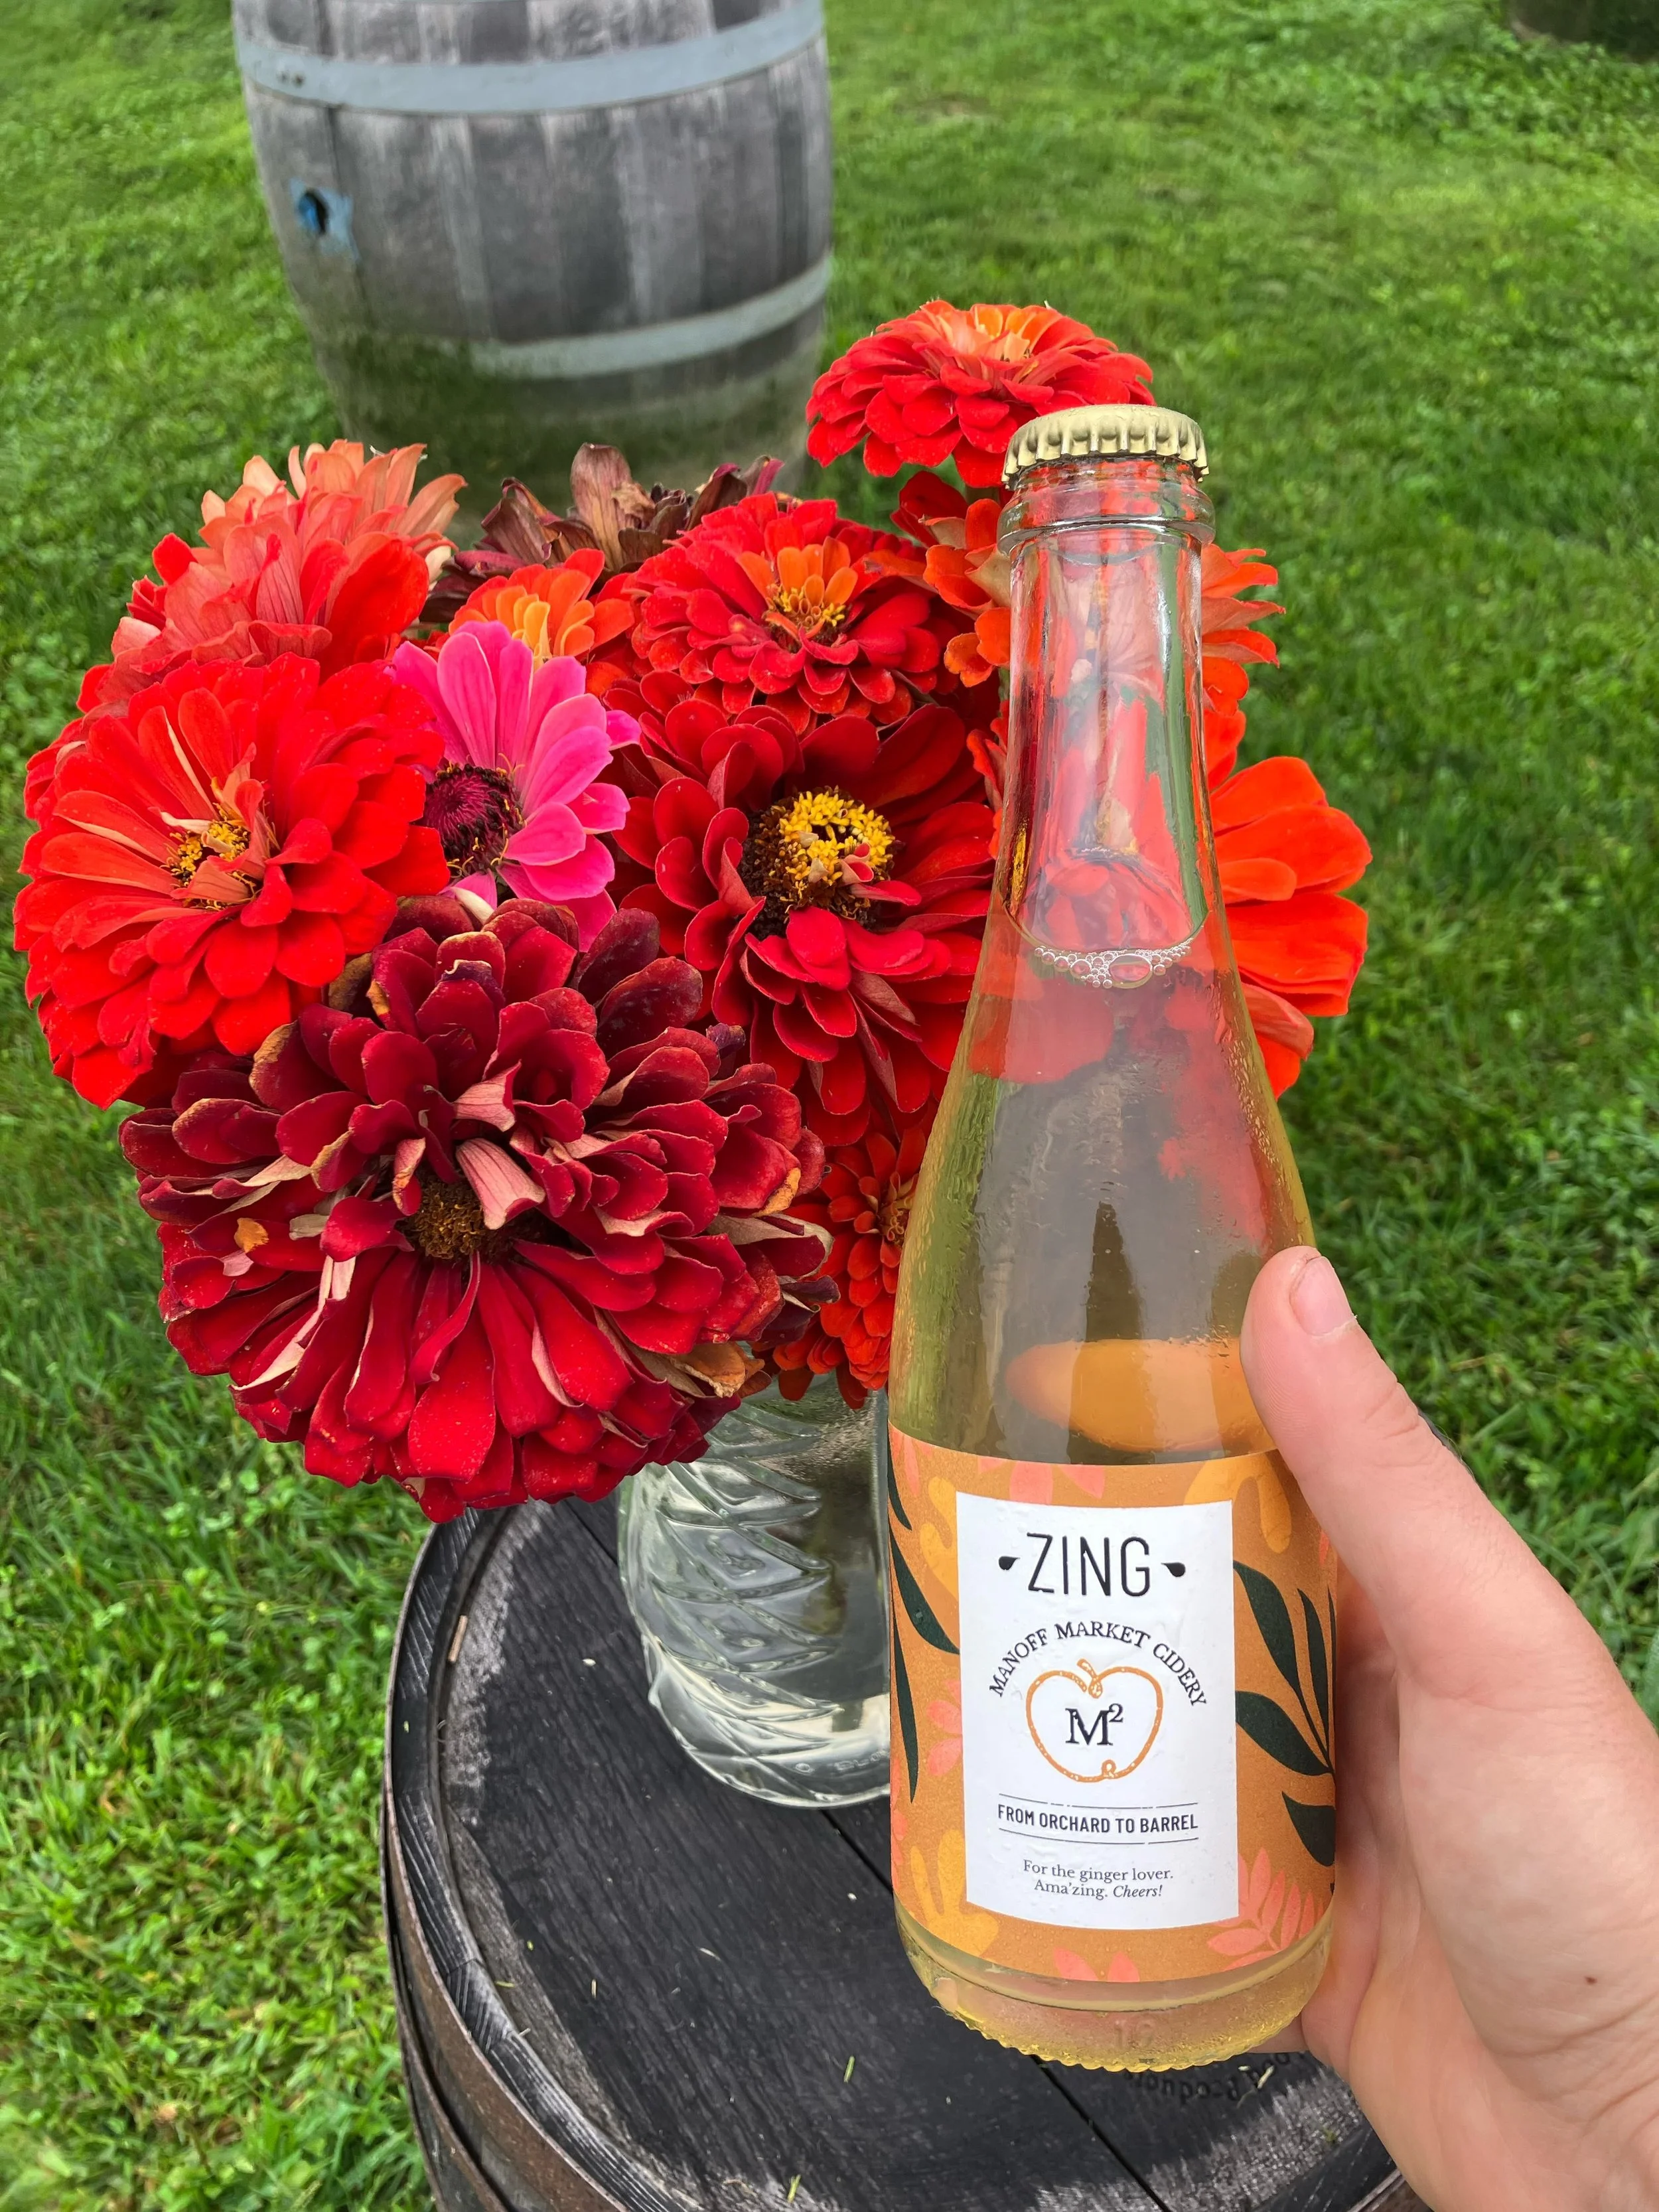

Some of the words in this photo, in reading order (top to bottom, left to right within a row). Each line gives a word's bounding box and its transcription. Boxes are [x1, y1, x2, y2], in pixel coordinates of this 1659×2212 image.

[1027, 1532, 1151, 1597] ZING
[989, 1628, 1047, 1697] MANOFF
[1054, 1621, 1151, 1648] MARKET
[1153, 1643, 1207, 1706] CIDERY
[998, 1804, 1035, 1826] FROM
[1039, 1812, 1110, 1833] ORCHARD
[1115, 1818, 1135, 1834] TO
[1140, 1814, 1198, 1833] BARREL
[1023, 1860, 1048, 1875] For
[1052, 1864, 1075, 1878] the
[1080, 1868, 1128, 1882] ginger
[1132, 1868, 1174, 1880] lover.
[1113, 1885, 1163, 1898] Cheers!
